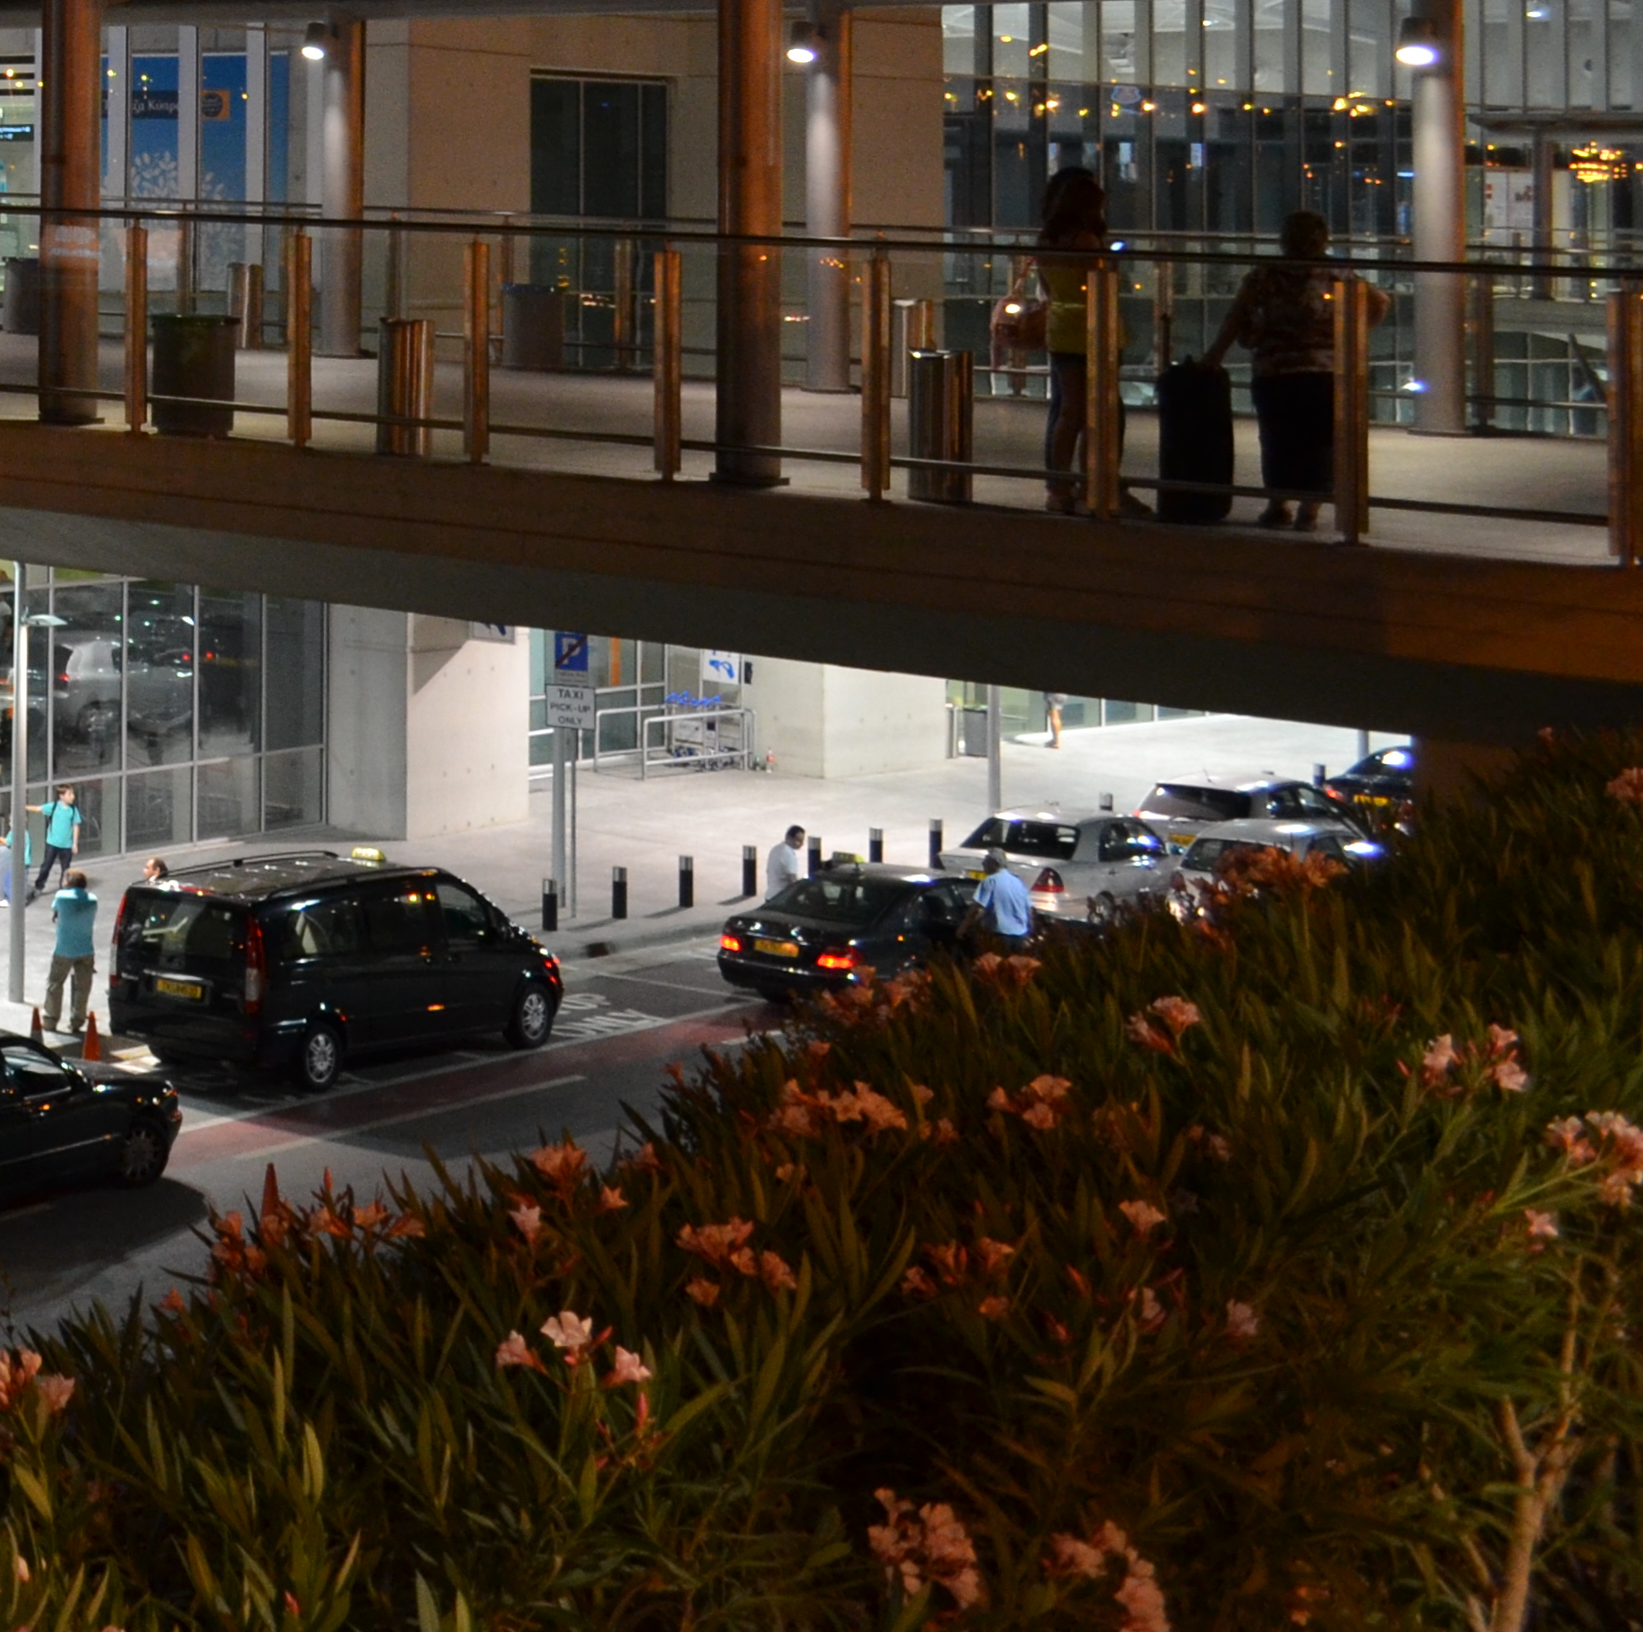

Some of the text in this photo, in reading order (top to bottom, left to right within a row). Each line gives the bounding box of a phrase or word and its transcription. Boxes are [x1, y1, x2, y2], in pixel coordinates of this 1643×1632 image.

[557, 688, 585, 701] TAXI
[549, 702, 591, 714] PICK-UP
[557, 715, 583, 726] ONLY
